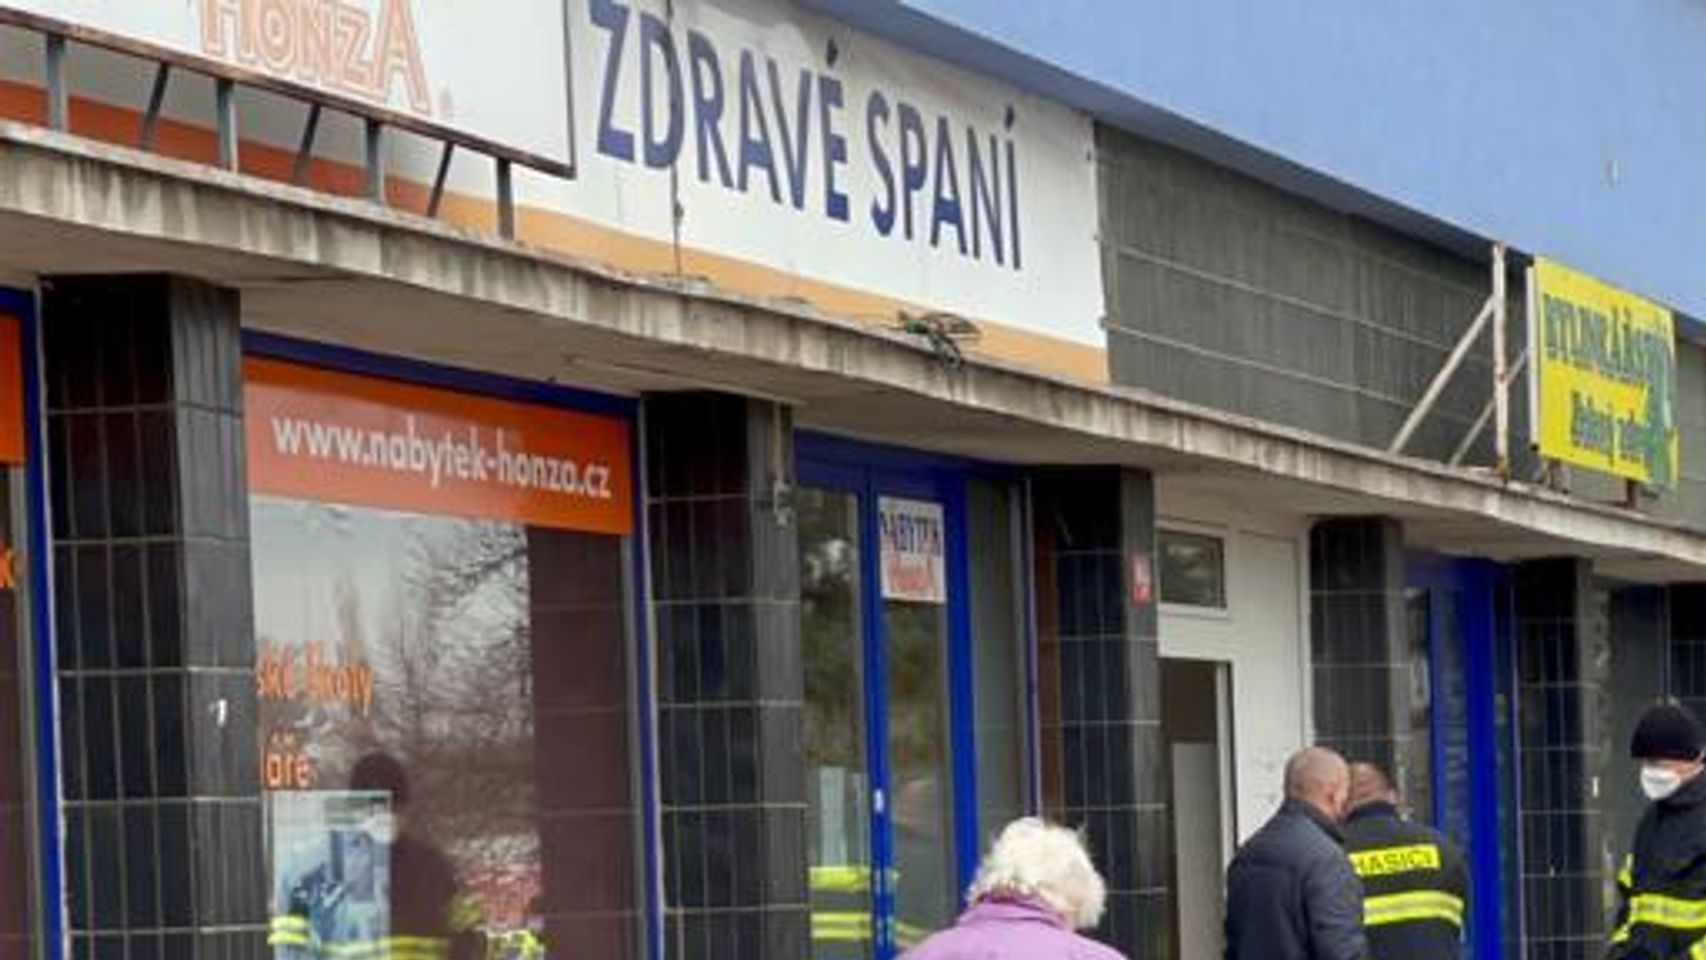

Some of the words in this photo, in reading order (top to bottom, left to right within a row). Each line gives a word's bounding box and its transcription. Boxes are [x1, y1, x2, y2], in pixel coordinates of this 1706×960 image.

[589, 0, 849, 224] ZDRAVÉ
[866, 90, 1022, 271] SPANÍ
[271, 411, 613, 499] www.nabytek-honza.cz
